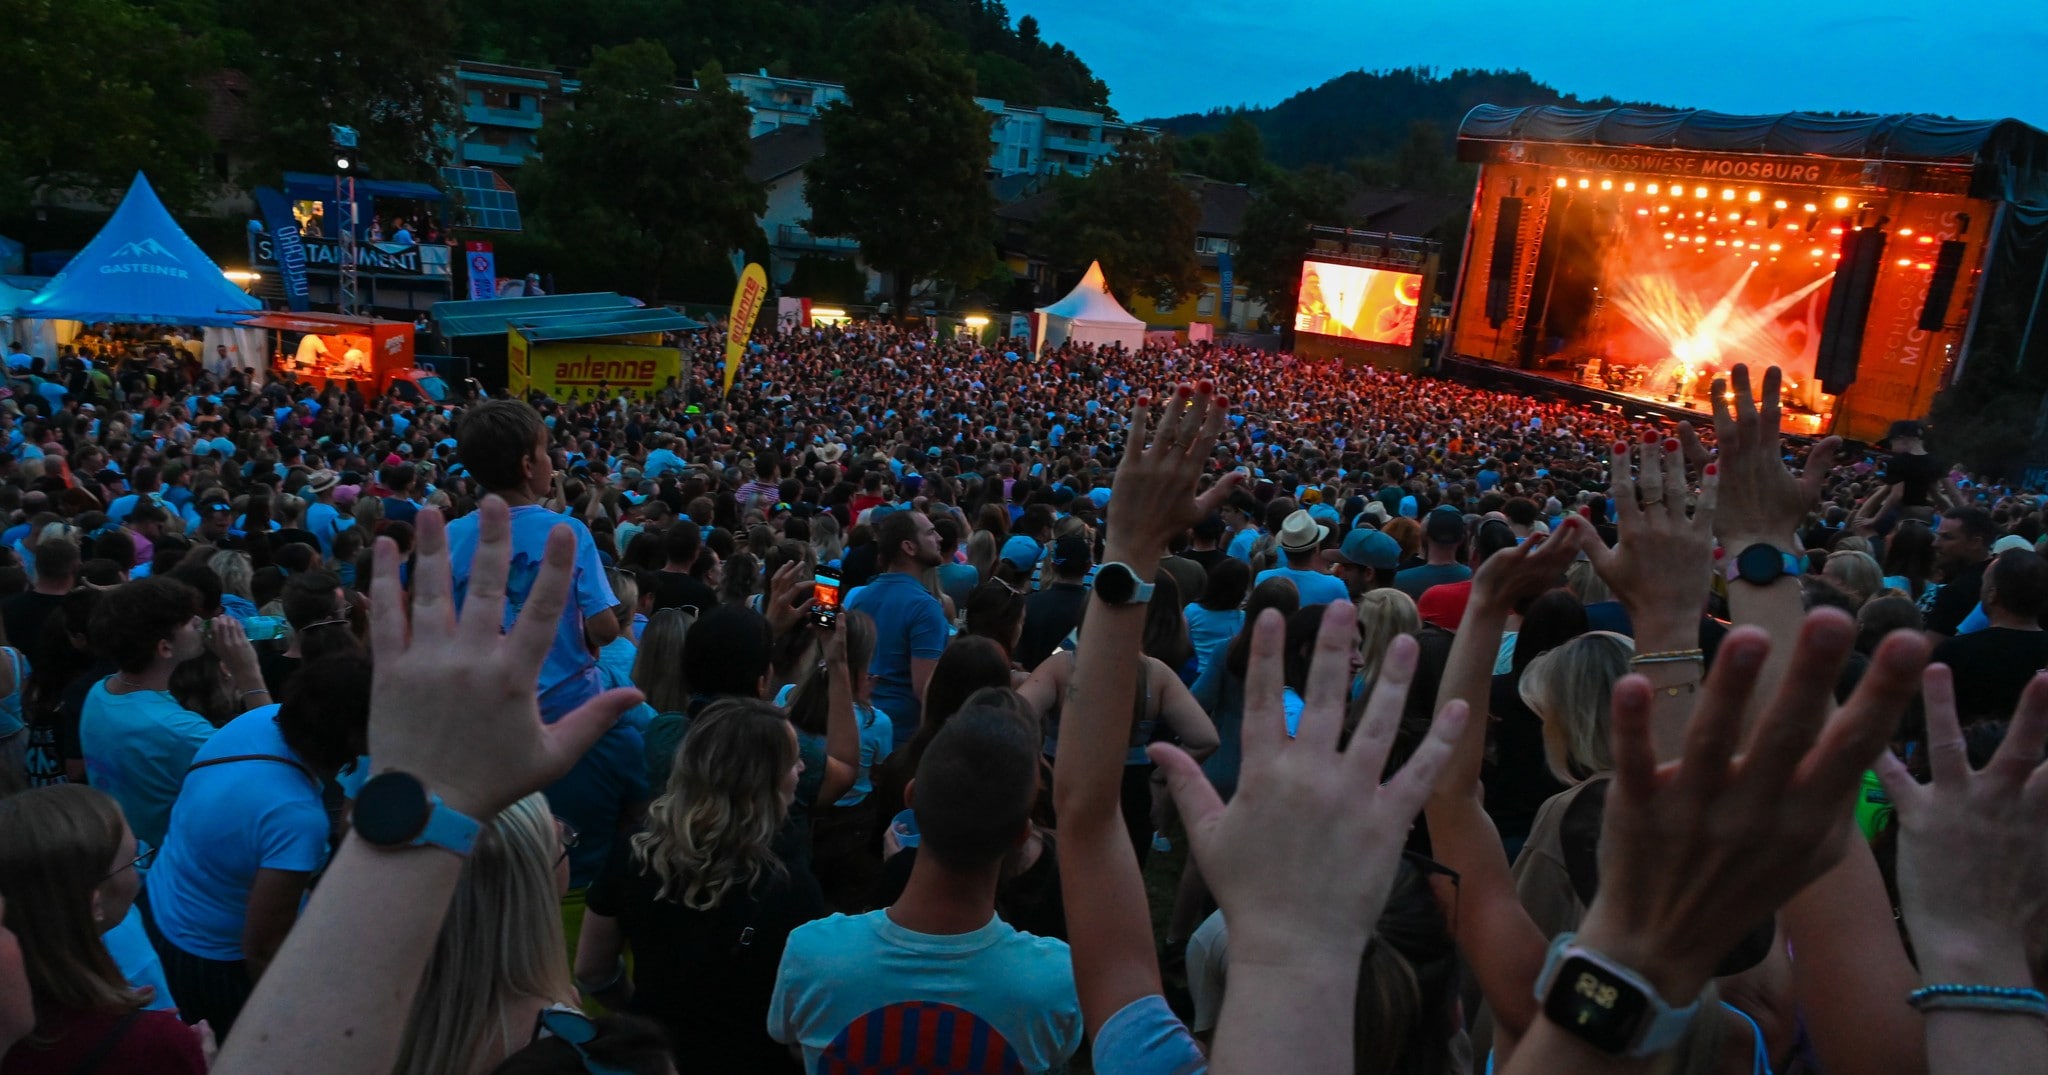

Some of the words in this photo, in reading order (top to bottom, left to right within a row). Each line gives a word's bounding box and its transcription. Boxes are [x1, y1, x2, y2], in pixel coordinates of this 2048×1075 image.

[1565, 151, 1696, 174] SCHLOSSWIESE
[1701, 158, 1821, 183] MOOSBURG
[100, 263, 189, 279] GASTEINER
[258, 240, 417, 271] STAIMENT
[1883, 209, 1938, 360] SCHLOSSWISE
[731, 276, 759, 343] antenne
[555, 354, 657, 380] antenne
